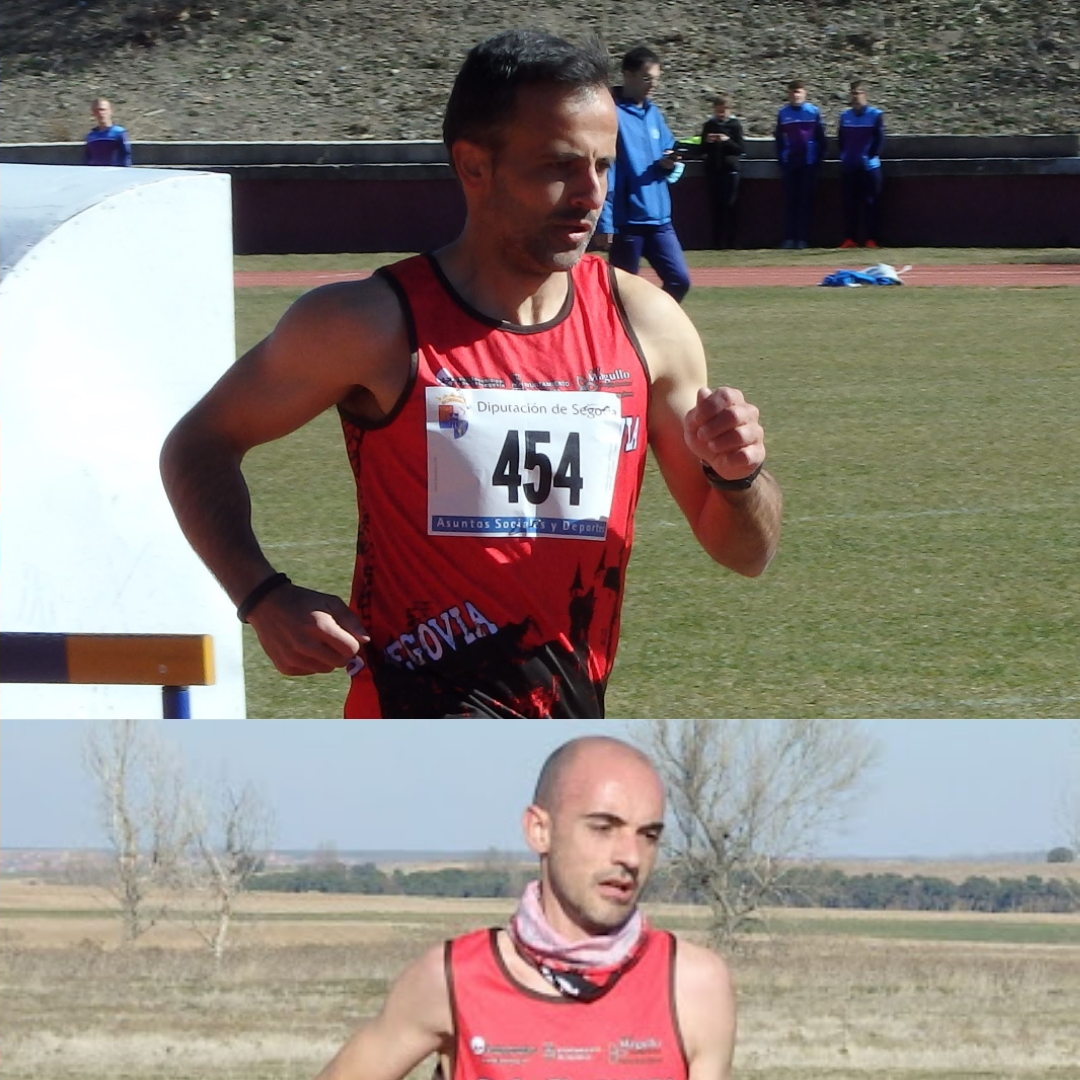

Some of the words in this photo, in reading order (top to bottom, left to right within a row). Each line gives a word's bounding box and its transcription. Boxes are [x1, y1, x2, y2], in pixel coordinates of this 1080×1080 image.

[477, 401, 547, 415] Diputación
[556, 402, 568, 414] de
[491, 430, 584, 506] 454
[436, 517, 490, 529] Asuntos
[550, 521, 557, 532] y
